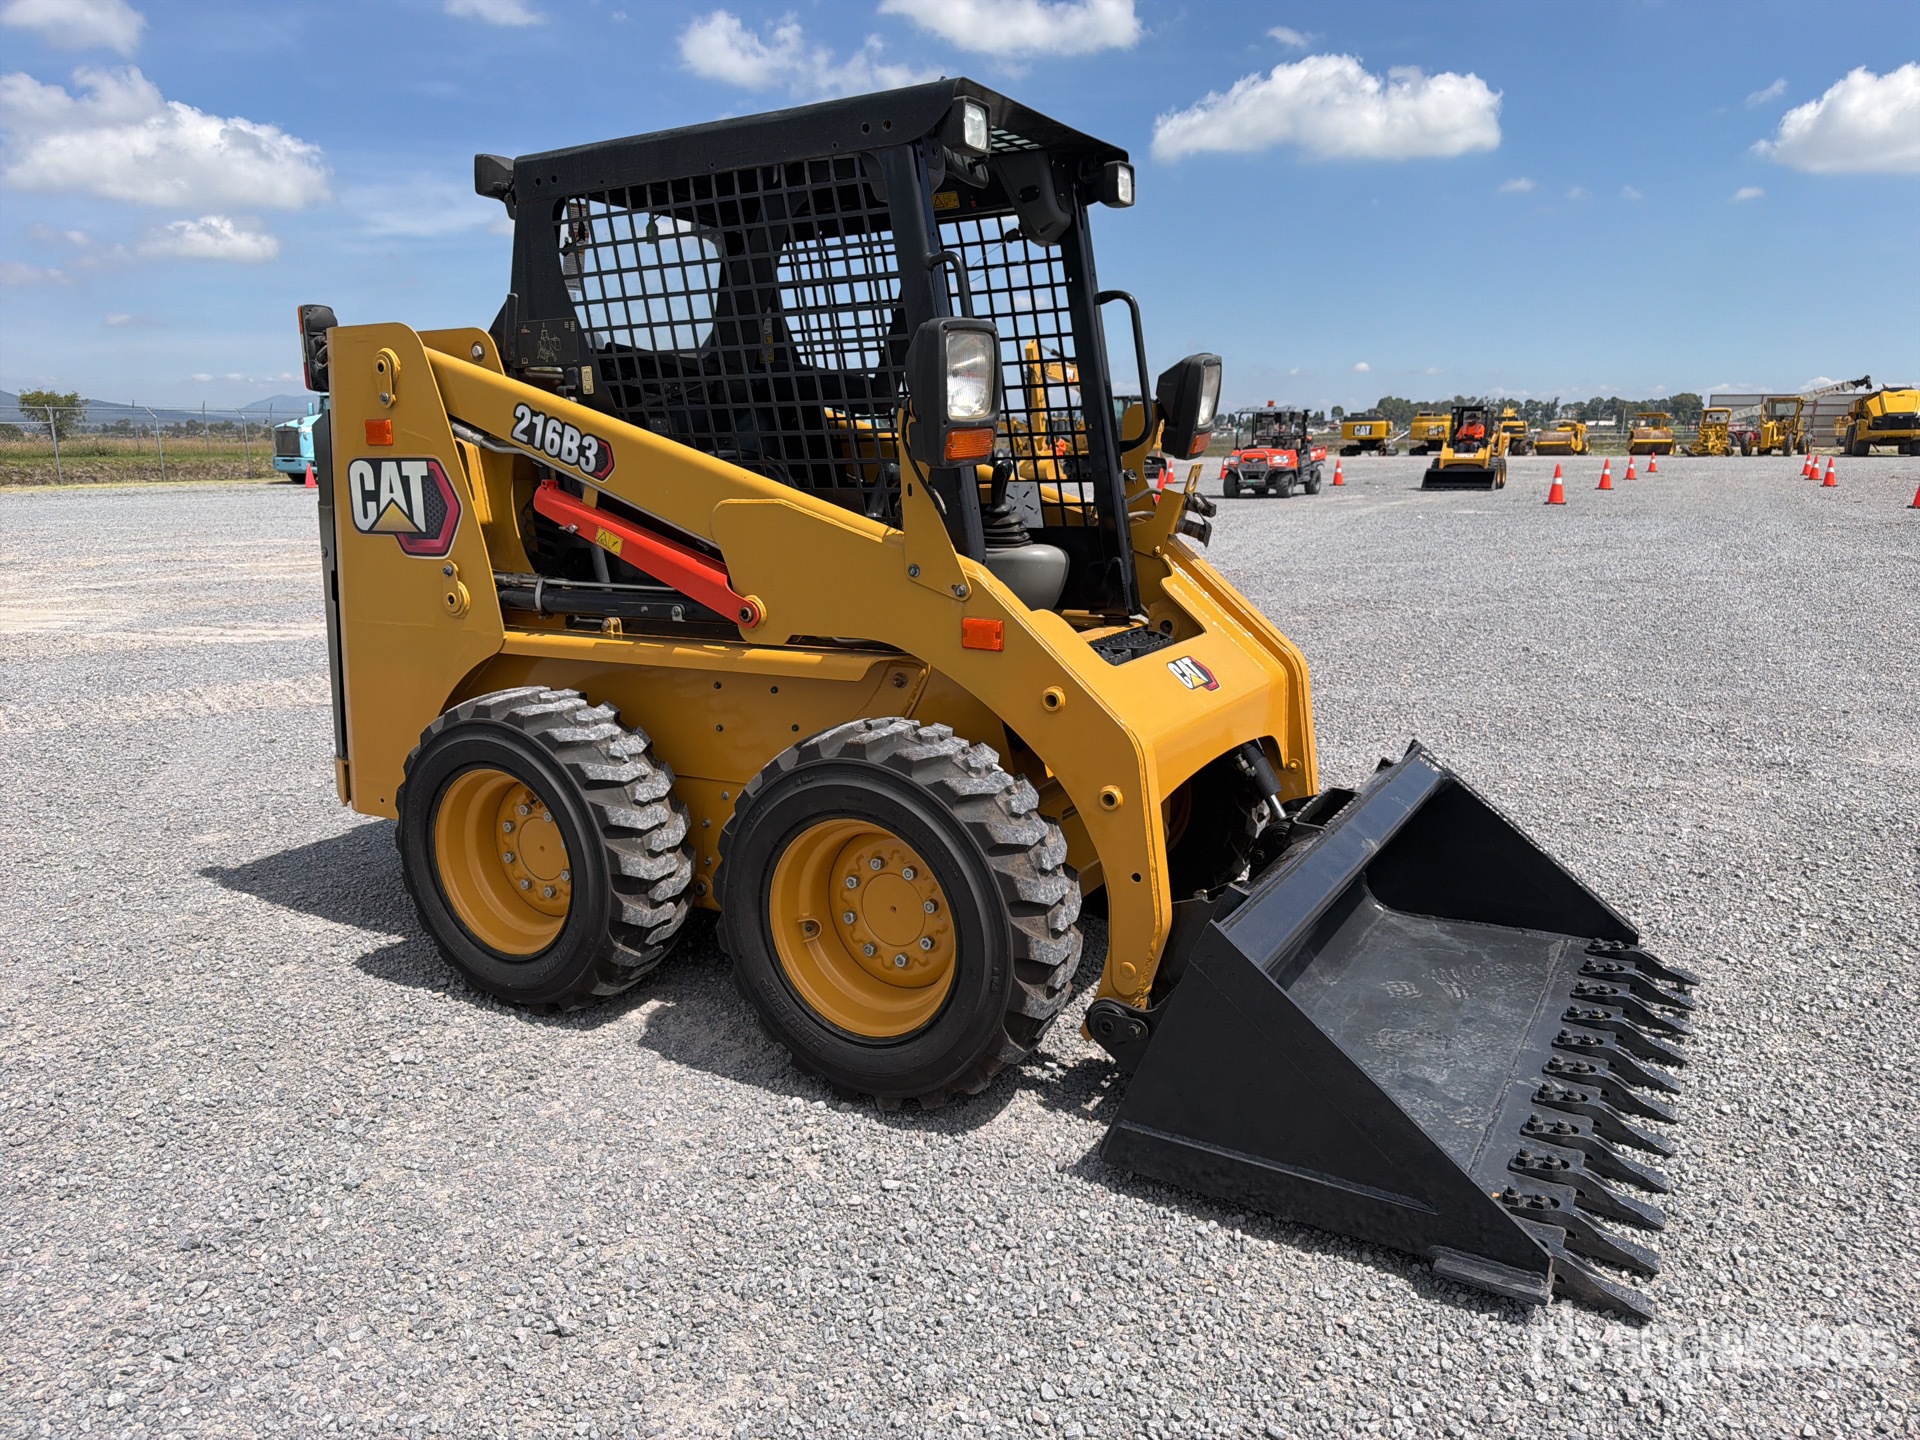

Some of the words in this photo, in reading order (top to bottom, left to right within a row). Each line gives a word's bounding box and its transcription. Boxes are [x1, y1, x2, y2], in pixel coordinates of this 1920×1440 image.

[512, 404, 599, 473] 216B3
[1354, 425, 1371, 436] CAT
[349, 460, 429, 533] CAT
[1167, 656, 1208, 690] CAT
